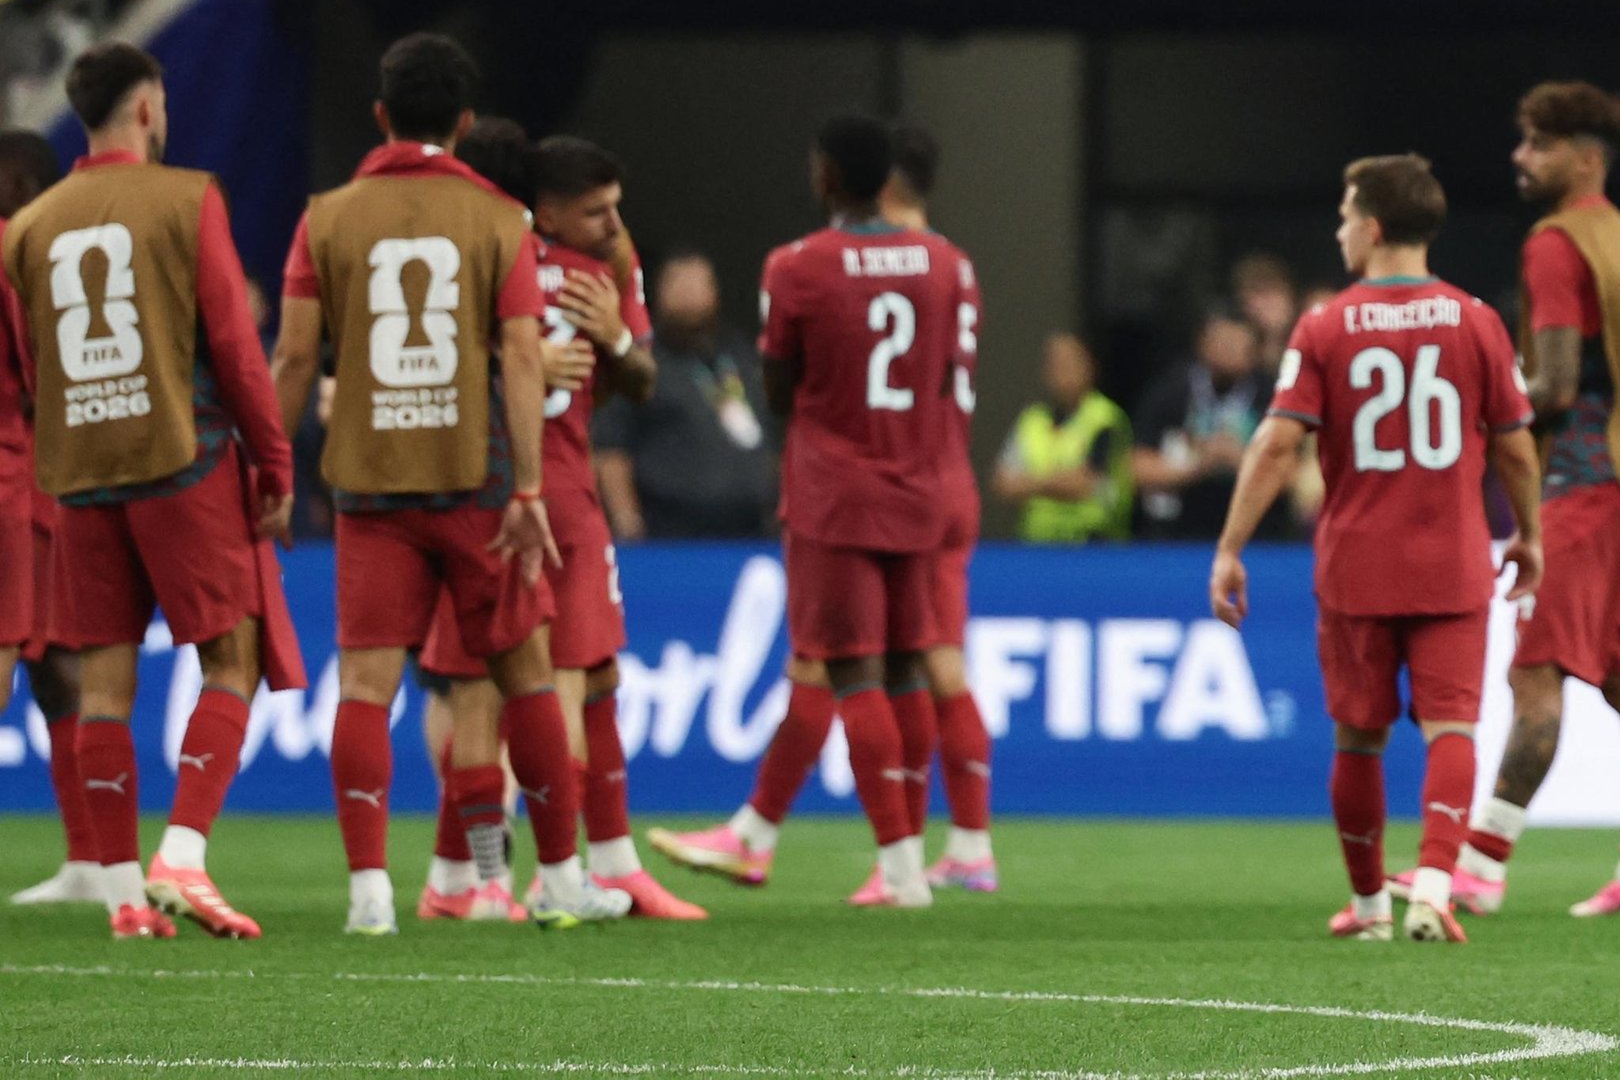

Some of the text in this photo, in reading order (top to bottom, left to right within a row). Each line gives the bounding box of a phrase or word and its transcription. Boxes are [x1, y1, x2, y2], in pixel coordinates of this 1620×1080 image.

[83, 347, 122, 363] FIFA
[867, 291, 916, 411] 2
[1348, 344, 1462, 471] 26
[966, 617, 1268, 741] FIFA
